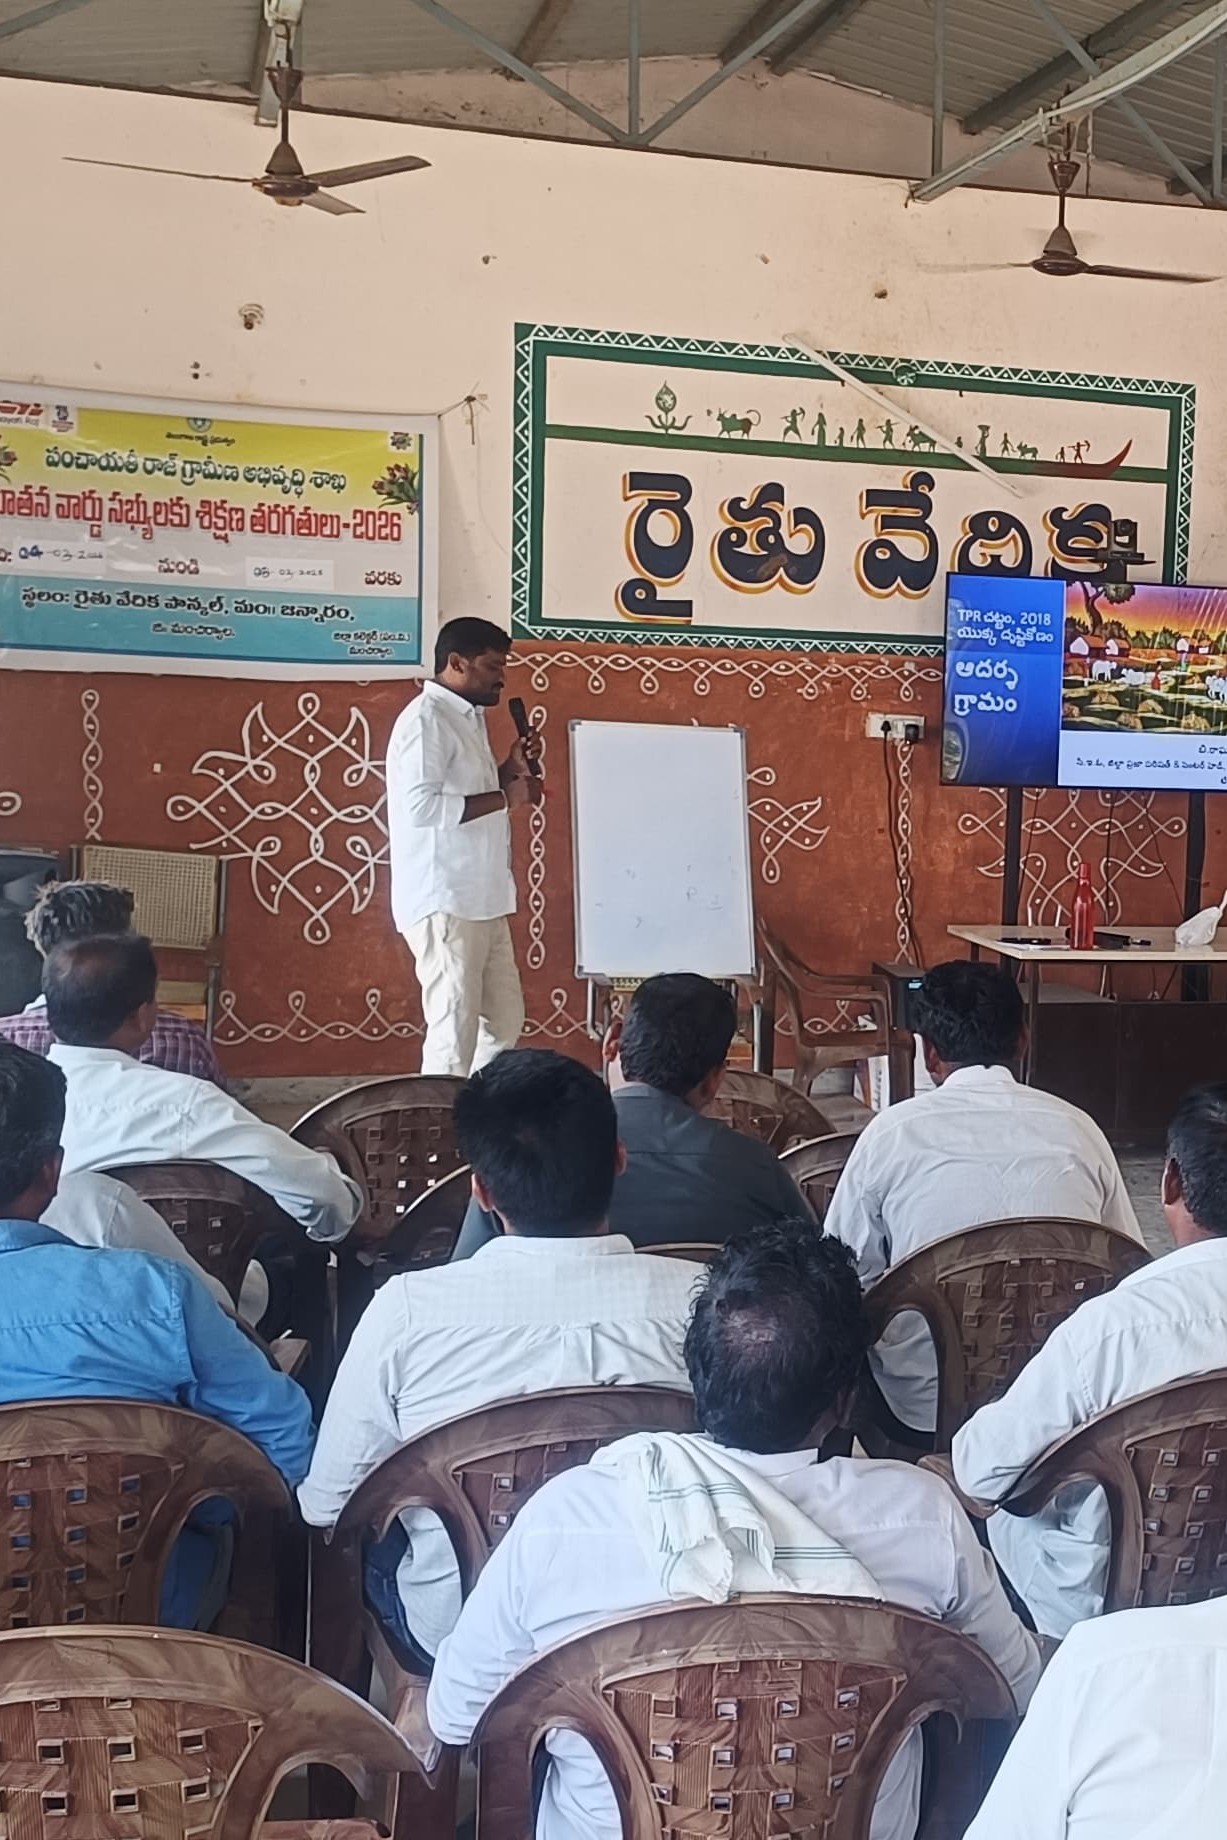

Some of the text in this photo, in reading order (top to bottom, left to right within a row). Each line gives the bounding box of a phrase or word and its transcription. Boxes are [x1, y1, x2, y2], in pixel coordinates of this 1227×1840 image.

[45, 446, 347, 498] పంచాయతీ రాజ్ గ్రామీణ అభివృద్ధి శాఖ
[55, 489, 103, 538] వార్డు
[108, 491, 191, 541] సభ్యులకు
[195, 499, 245, 543] శిక్షణ
[614, 469, 1113, 626] రైతు వేదిక
[158, 558, 200, 575] నుండి
[364, 570, 403, 586] వరకు
[74, 589, 112, 609] రైతు
[116, 590, 160, 609] వేదిక
[957, 608, 982, 622] TPR
[1020, 612, 1052, 626] 2018
[957, 626, 1054, 648] యొక్క దృష్టికోణం
[955, 658, 1019, 691] ఆదర్శ
[954, 691, 1018, 716] గ్రామం
